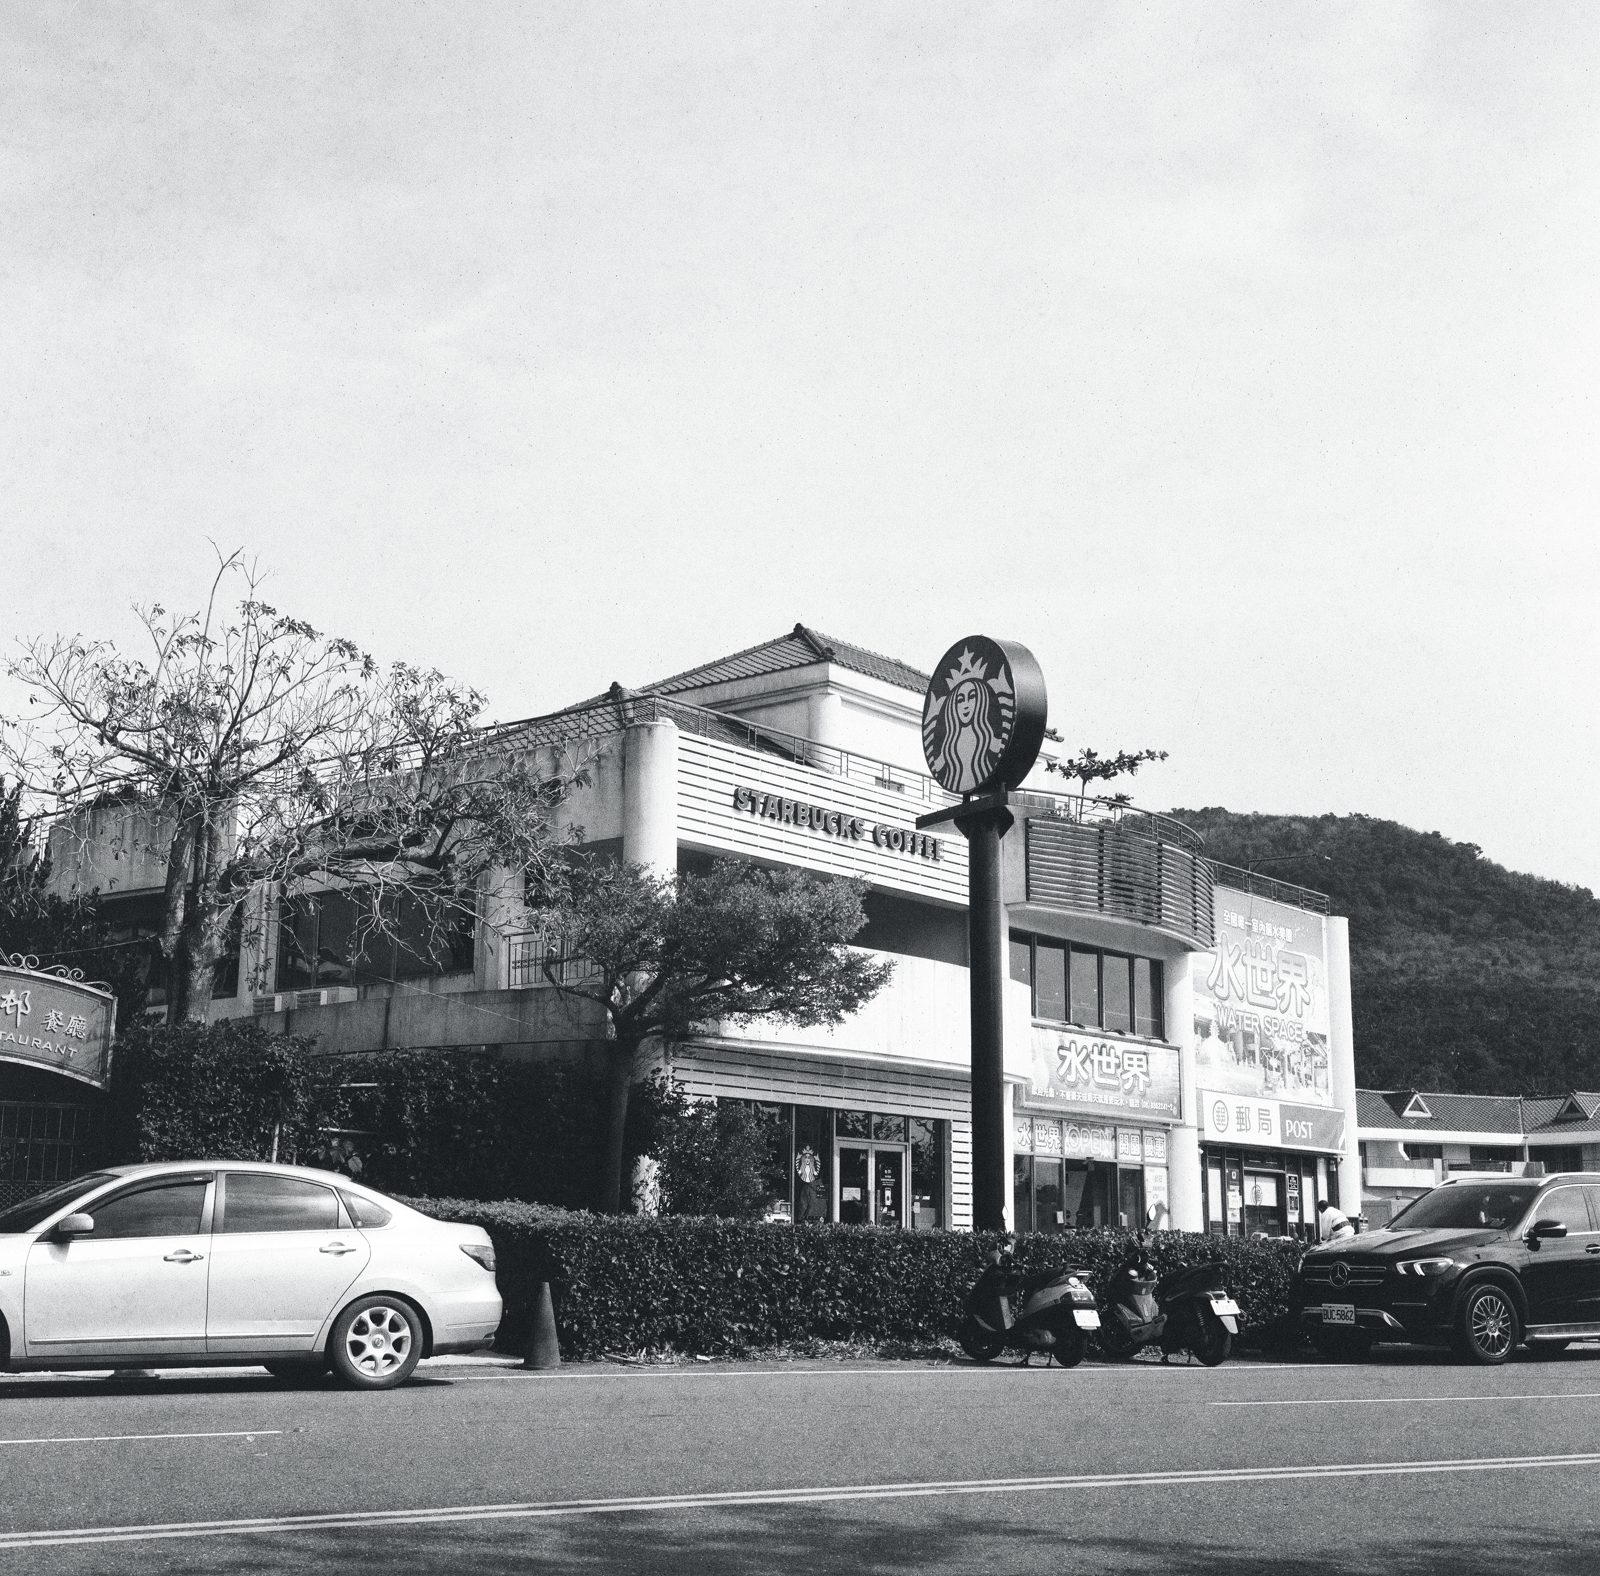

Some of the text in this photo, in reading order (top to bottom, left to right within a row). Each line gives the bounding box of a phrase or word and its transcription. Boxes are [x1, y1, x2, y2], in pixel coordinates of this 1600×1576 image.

[734, 787, 945, 861] STARBUCKS COFFEE
[1207, 931, 1311, 1017] 水世界
[41, 1009, 86, 1037] 餐廳
[1216, 1004, 1303, 1043] WATER SPACE
[1058, 1041, 1150, 1094] 水世界
[1018, 1122, 1061, 1150] 水世界
[1235, 1106, 1313, 1139] 郵局 POST
